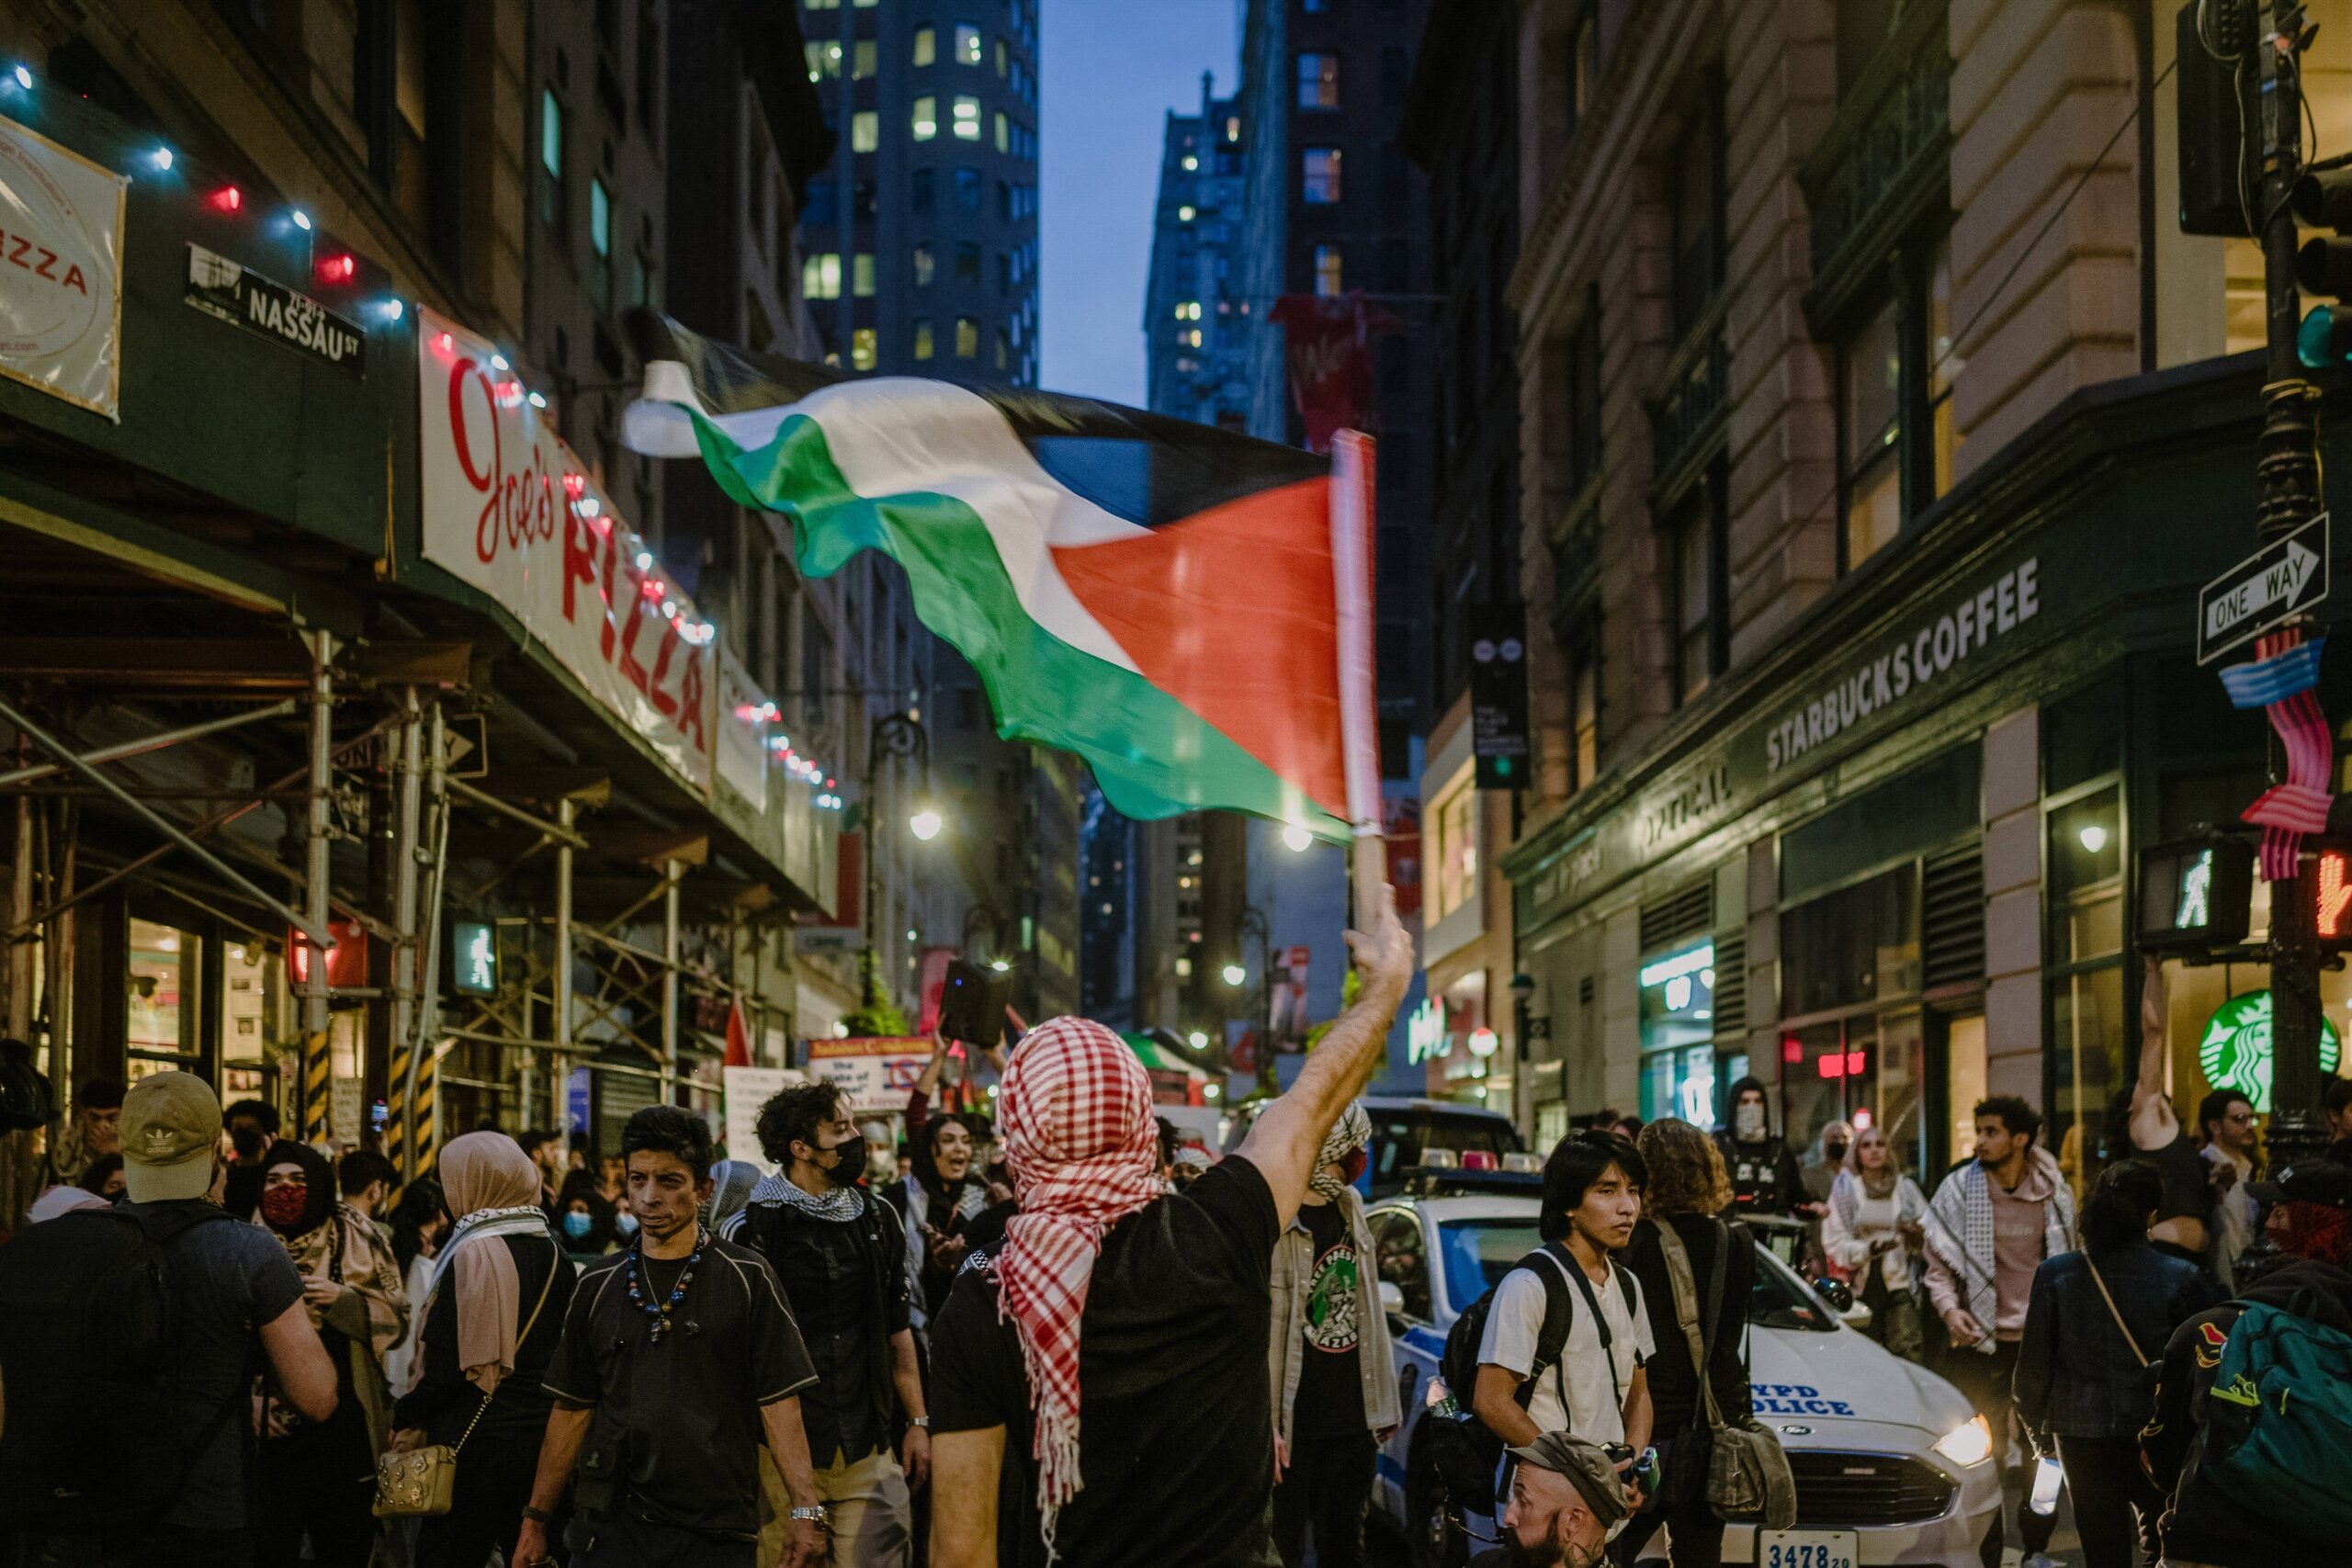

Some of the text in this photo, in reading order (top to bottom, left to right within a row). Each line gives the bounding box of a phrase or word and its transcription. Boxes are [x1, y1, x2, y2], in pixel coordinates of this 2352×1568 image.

[249, 287, 343, 362] NASSAU
[345, 333, 359, 356] ST
[448, 357, 553, 564] Joe's
[2216, 553, 2305, 629] ONE WAY
[1766, 557, 2039, 773] STARBUCKS COFFEE
[1750, 1383, 1819, 1397] YPD
[1751, 1398, 1854, 1416] OLICE
[1769, 1544, 1828, 1568] 3478
